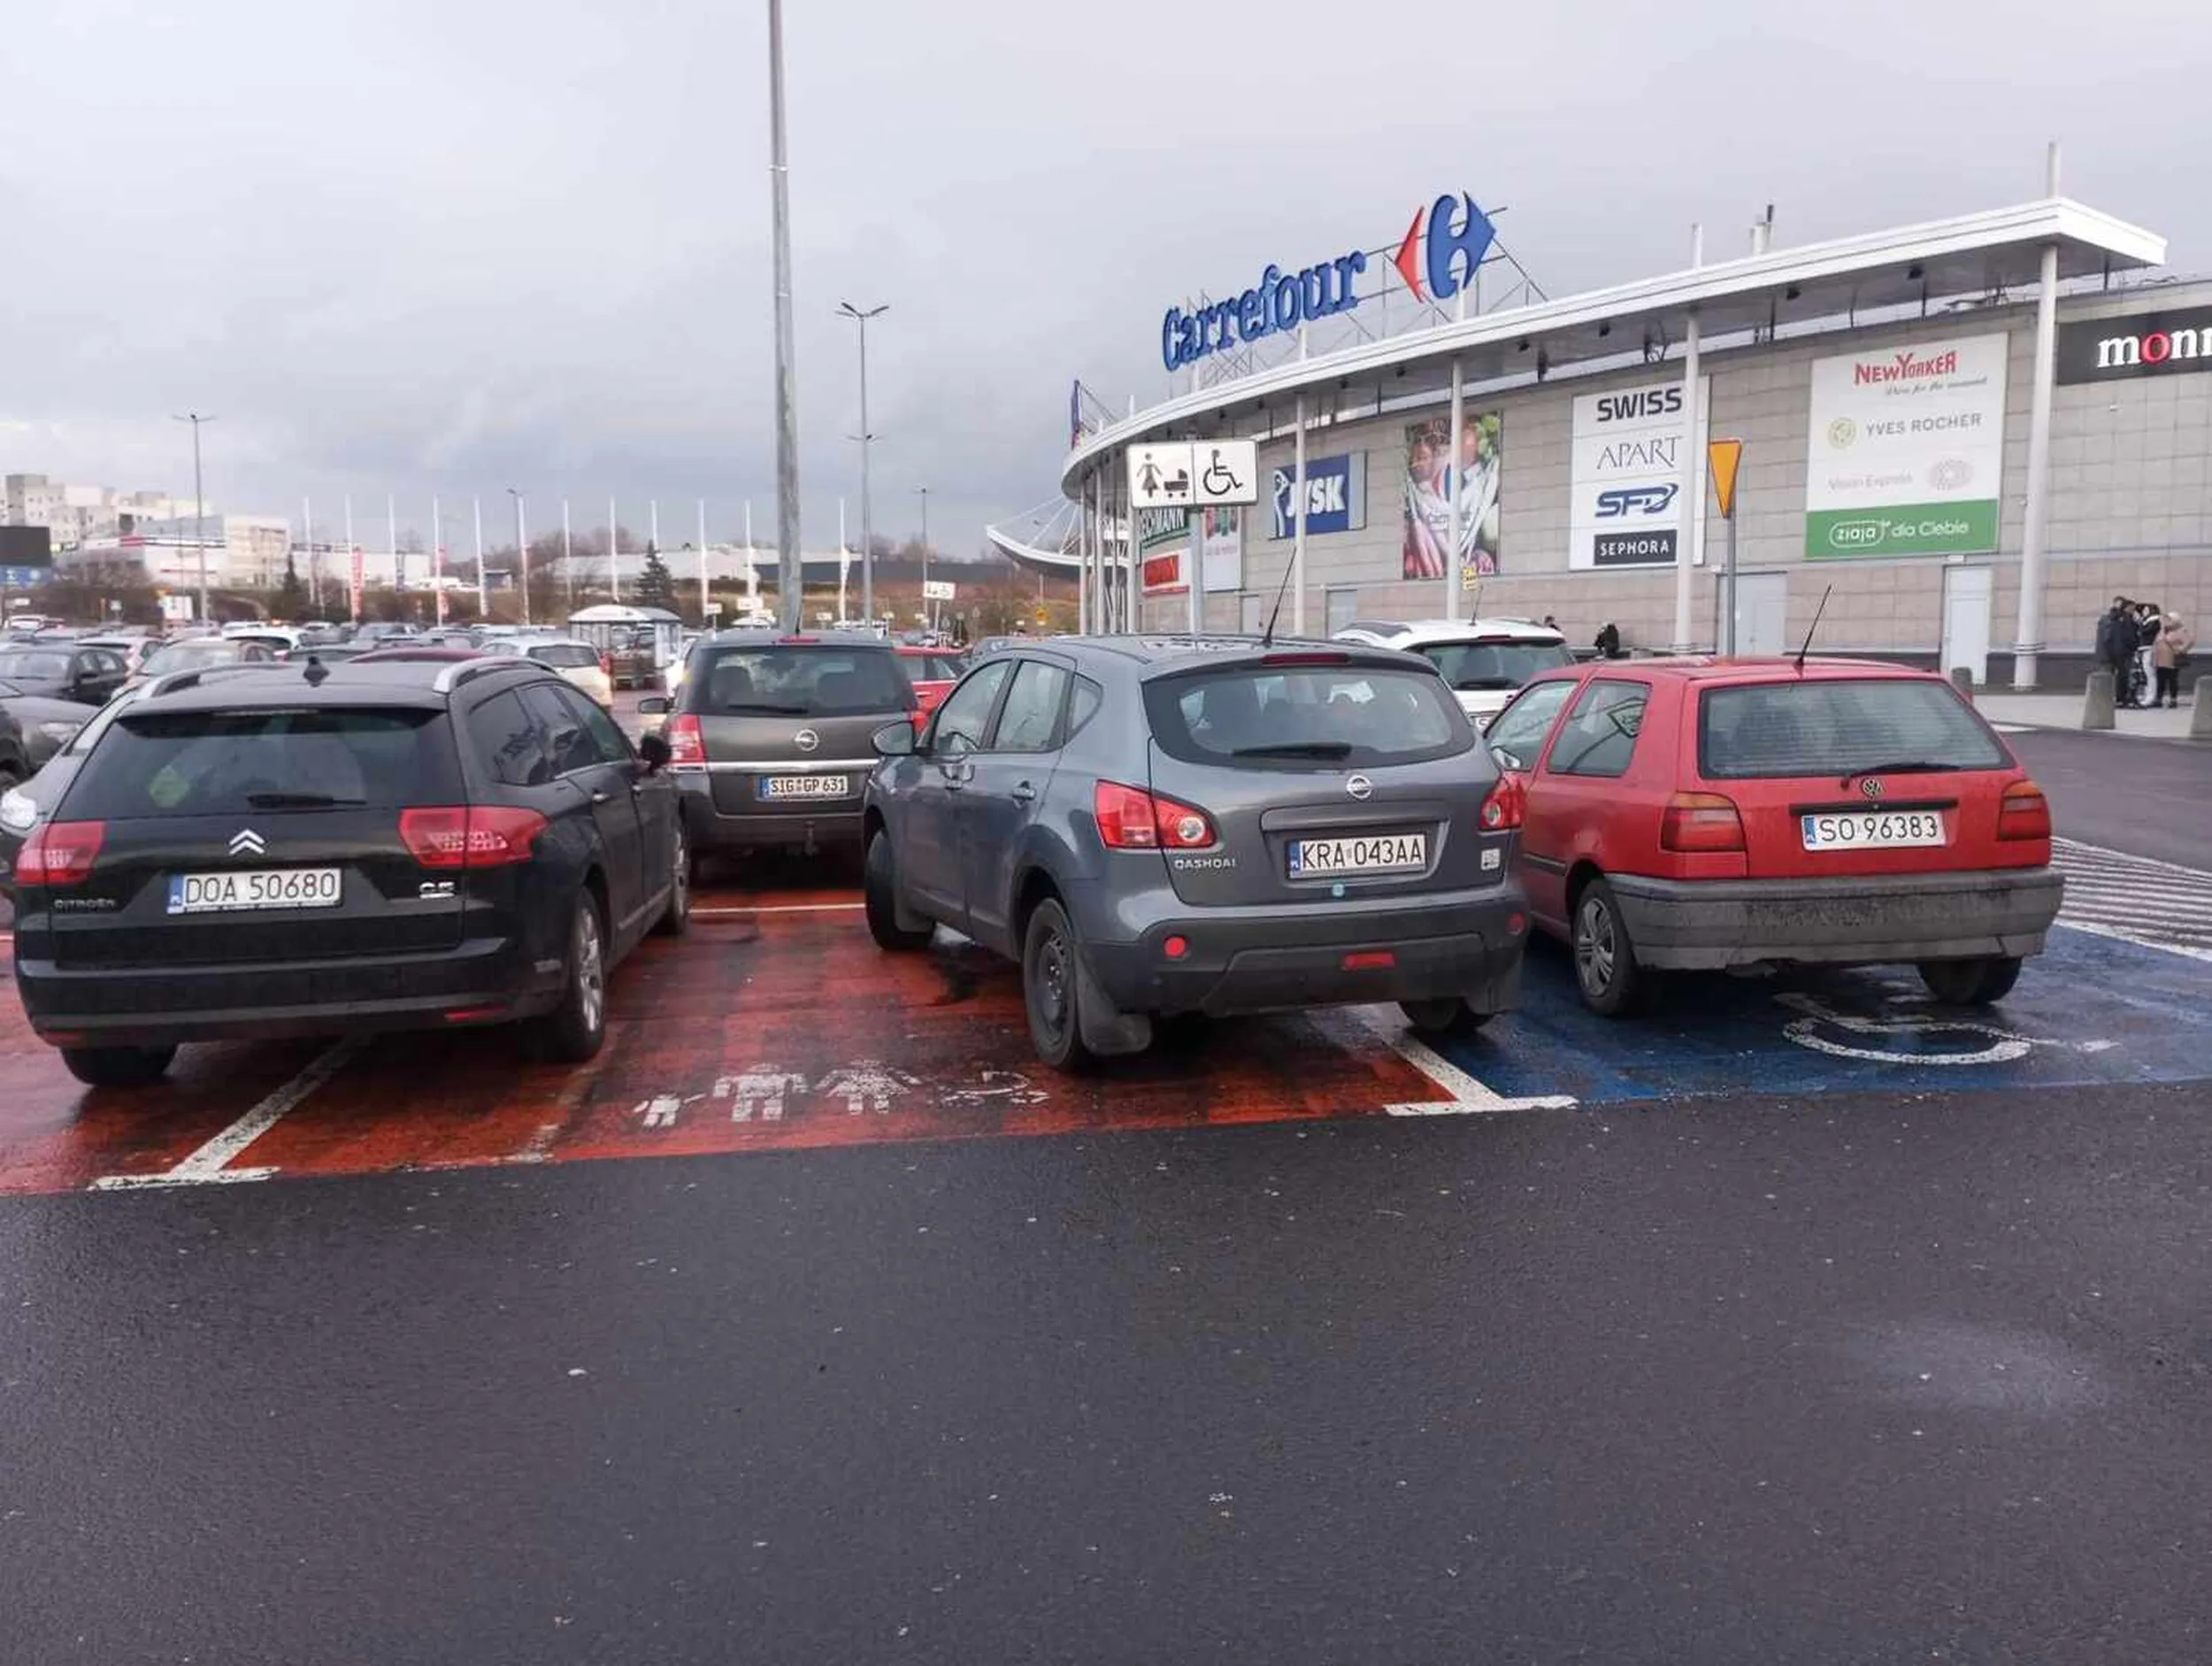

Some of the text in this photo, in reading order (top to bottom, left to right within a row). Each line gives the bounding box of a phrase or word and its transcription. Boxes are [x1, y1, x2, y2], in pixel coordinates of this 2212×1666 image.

[1163, 250, 1367, 372] Carrefour
[1597, 388, 1682, 422] SWISS
[1866, 412, 1983, 435] YVES ROCHER
[1596, 435, 1684, 470] APART
[1600, 540, 1670, 557] SEPHORA
[771, 777, 845, 793] SIG GP 631
[1819, 816, 1938, 841] SO 96383
[1302, 842, 1345, 868] KRA
[1355, 839, 1422, 865] 043AA
[186, 872, 336, 903] DOA 50680
